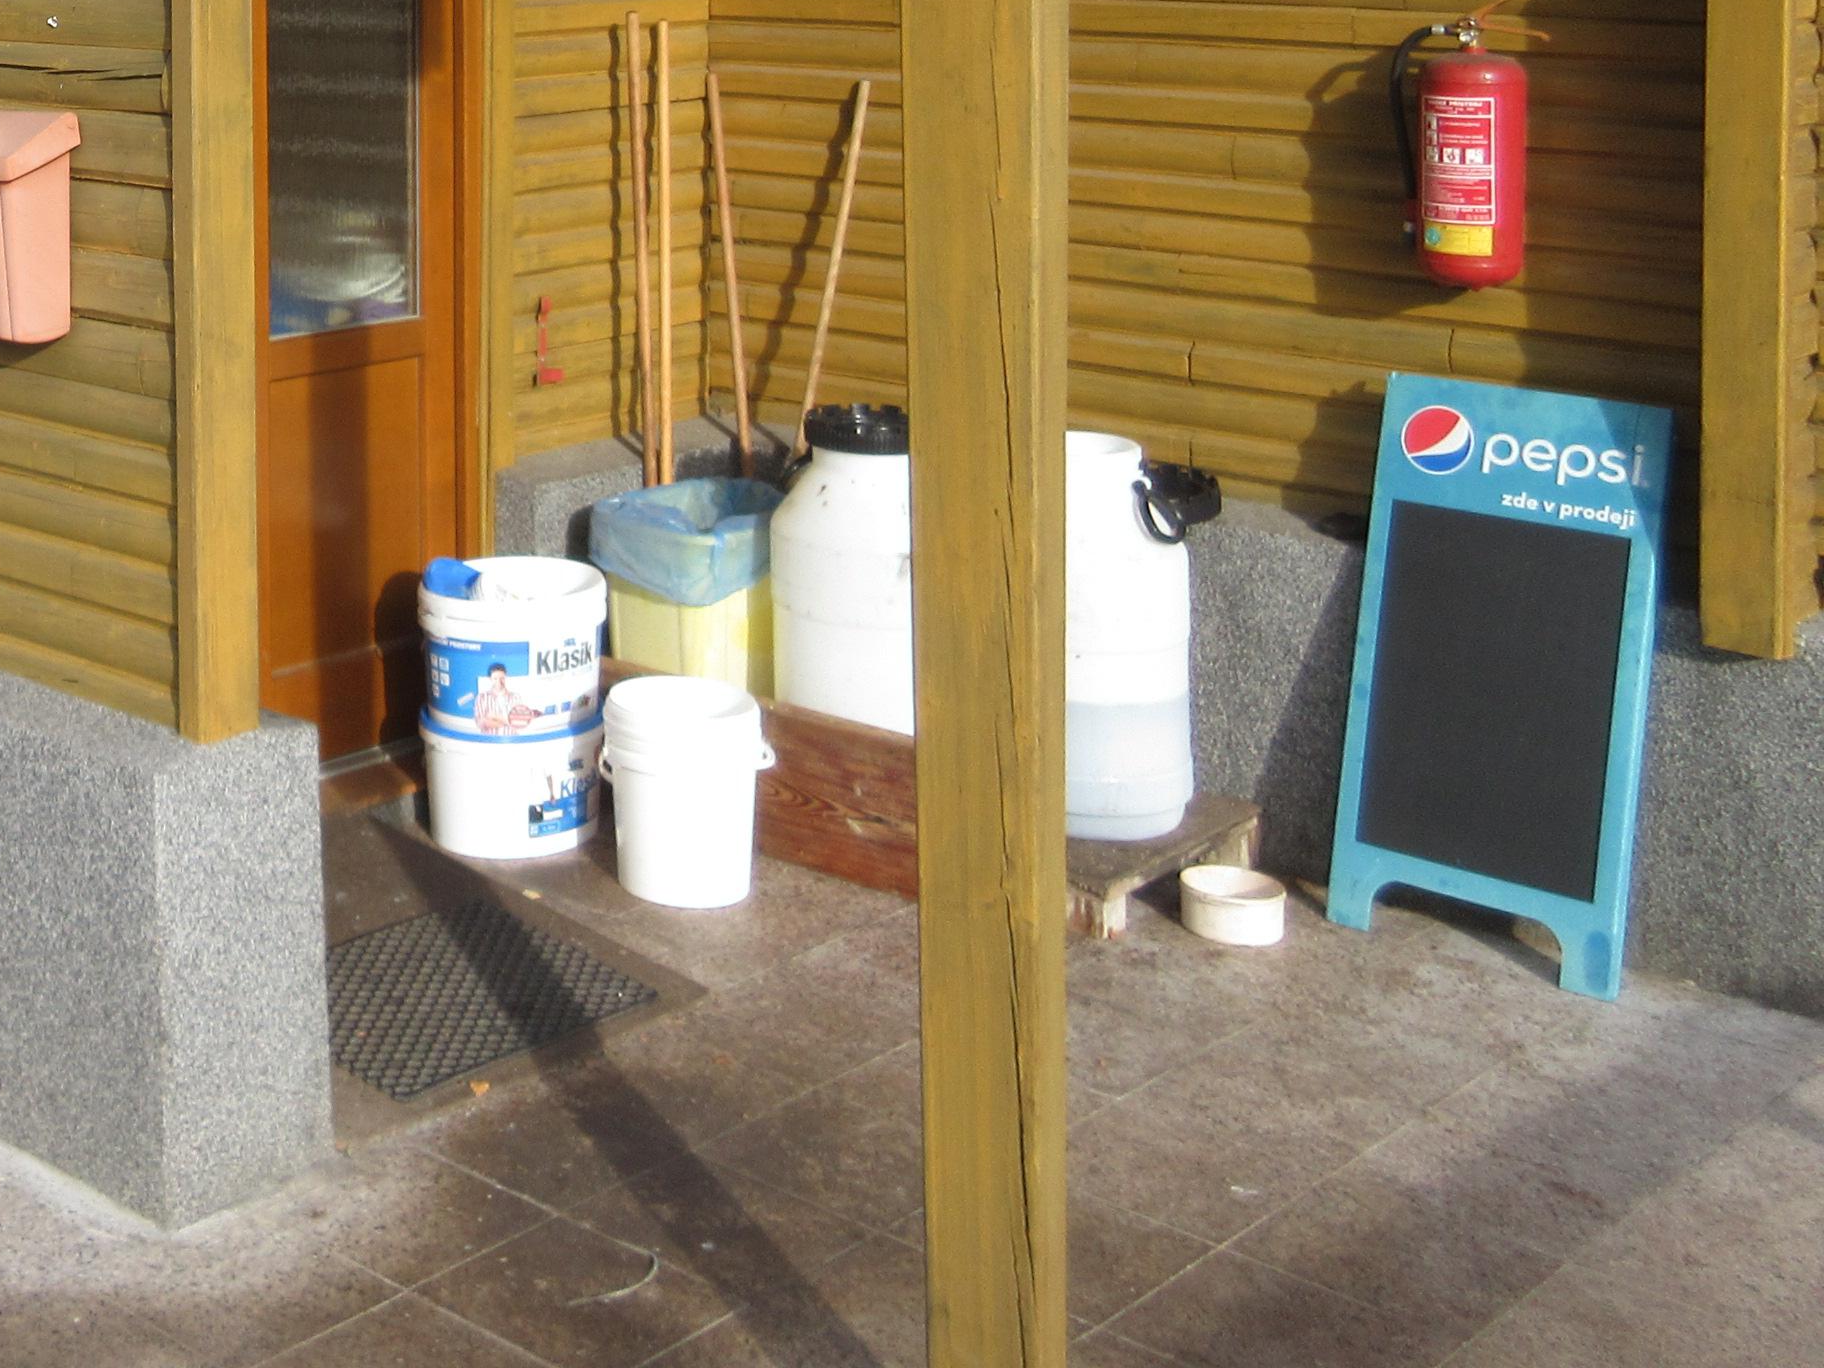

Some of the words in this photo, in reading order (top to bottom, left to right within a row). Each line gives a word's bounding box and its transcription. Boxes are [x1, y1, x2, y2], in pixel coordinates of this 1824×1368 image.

[1482, 433, 1644, 486] pepsi
[1501, 493, 1538, 510] zde
[1543, 501, 1555, 513] v
[1559, 505, 1636, 530] prodeji
[536, 640, 592, 675] Klasik
